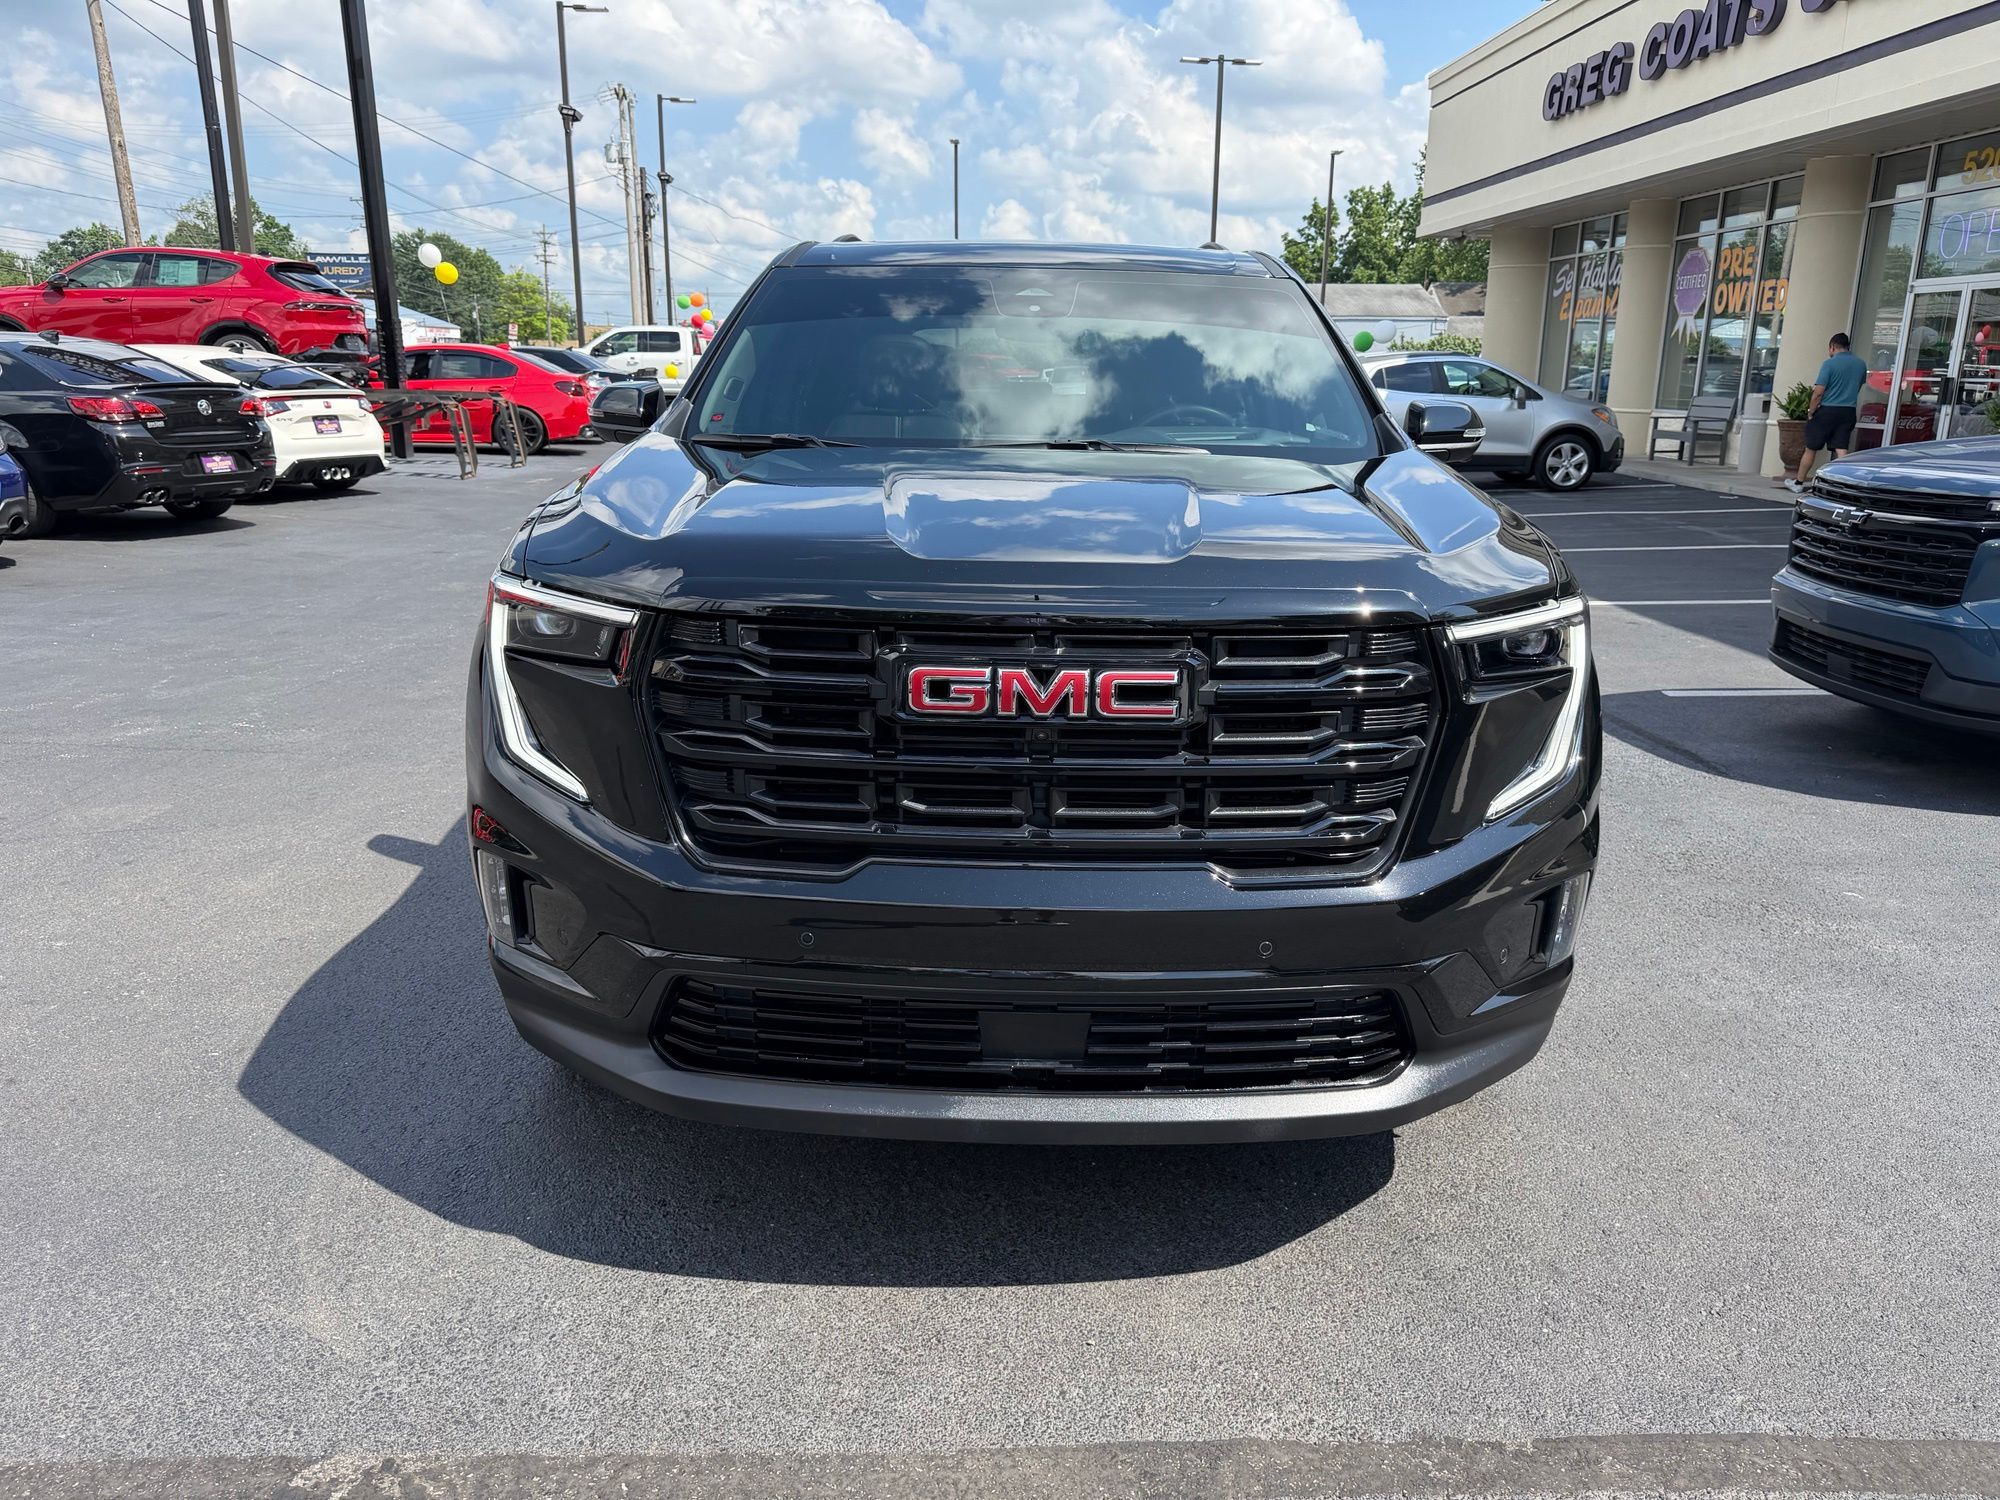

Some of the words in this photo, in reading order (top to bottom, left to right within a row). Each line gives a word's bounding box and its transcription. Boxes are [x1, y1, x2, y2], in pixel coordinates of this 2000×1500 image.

[1542, 41, 1635, 121] GREG
[1639, 0, 1788, 81] COATS
[1552, 263, 1575, 298] Se
[1675, 273, 1708, 291] CERTIFIED
[1713, 278, 1790, 316] OWNED
[907, 665, 1184, 719] GMC
